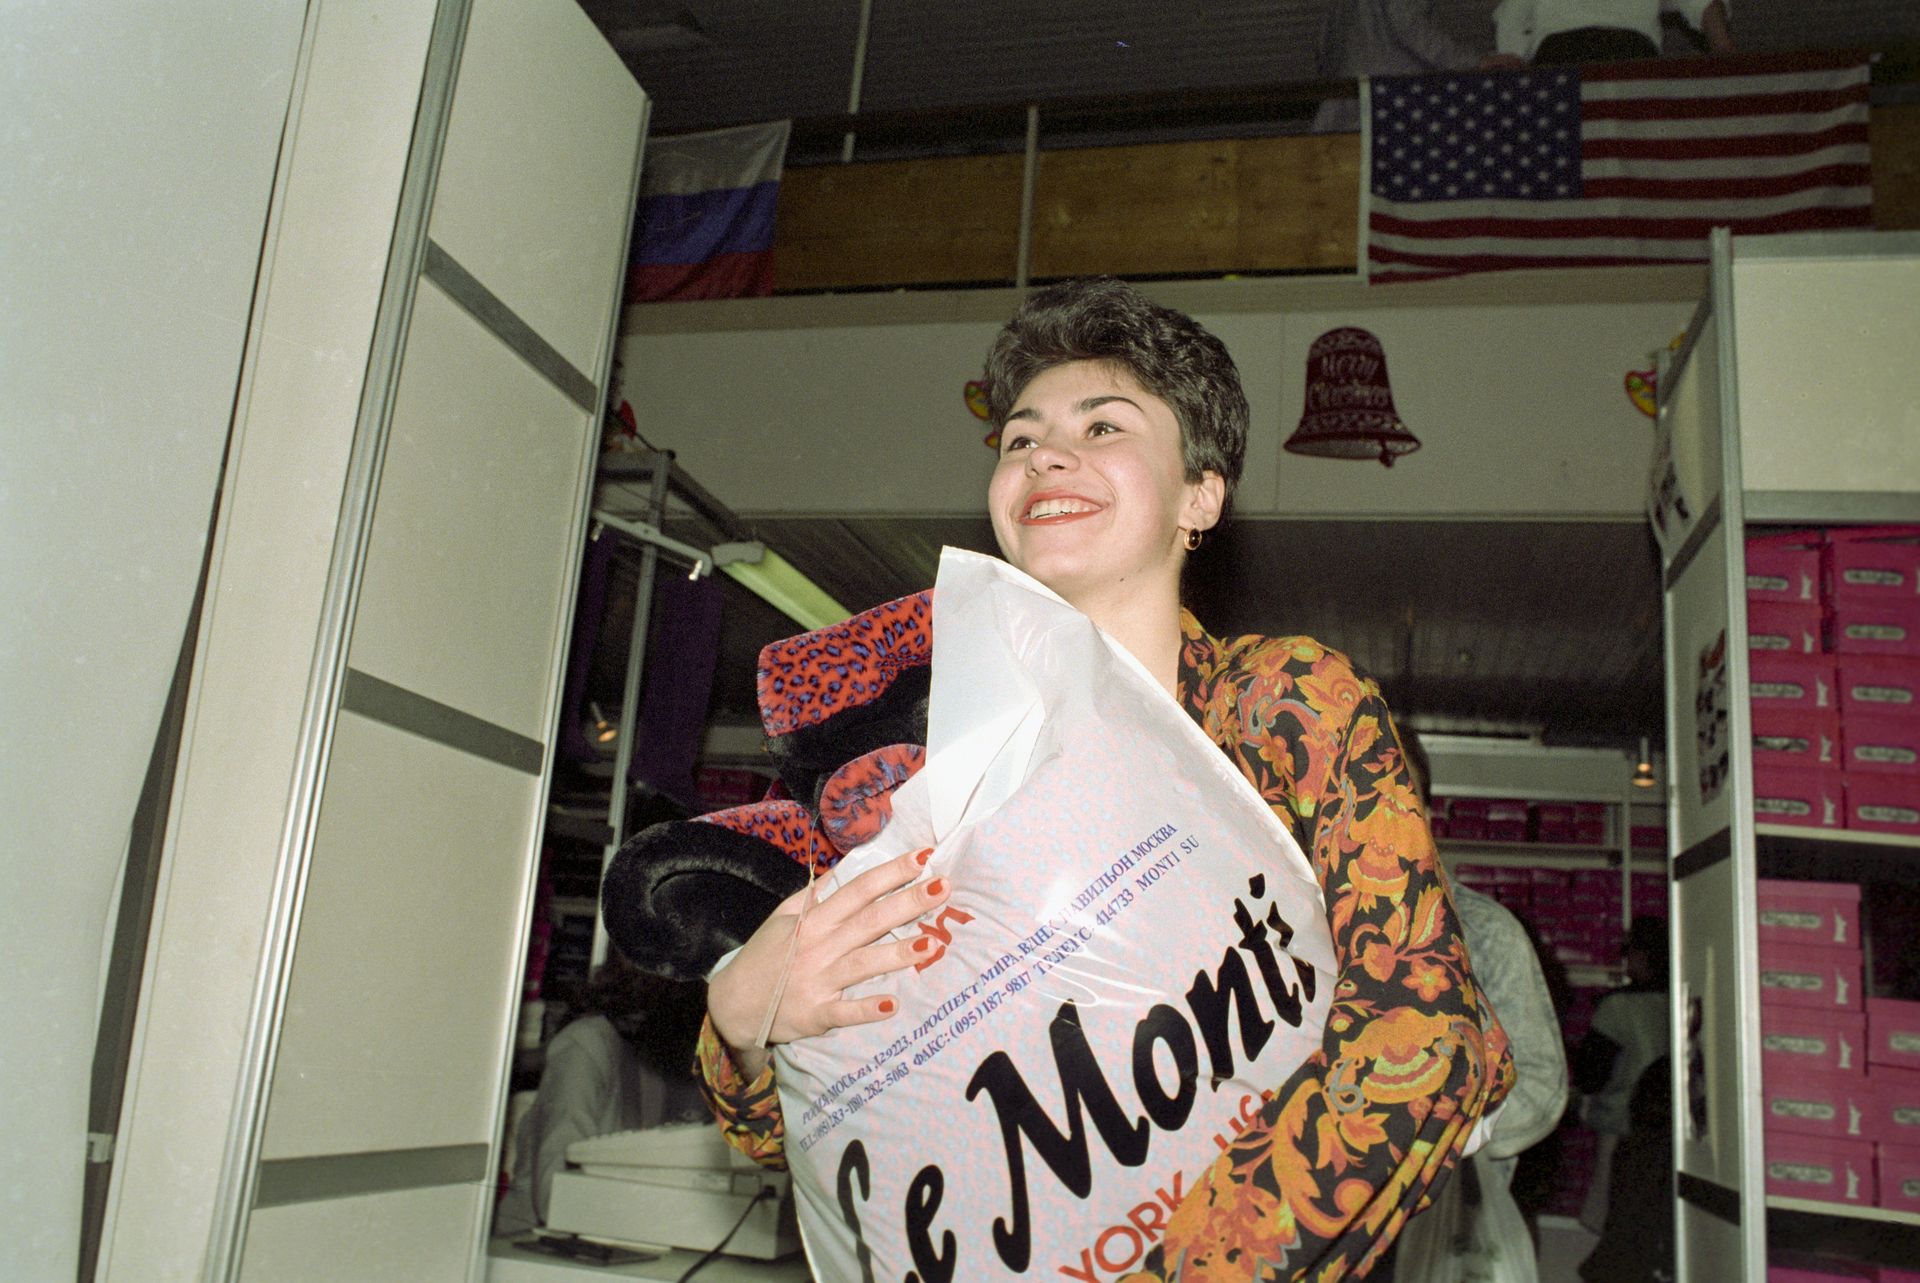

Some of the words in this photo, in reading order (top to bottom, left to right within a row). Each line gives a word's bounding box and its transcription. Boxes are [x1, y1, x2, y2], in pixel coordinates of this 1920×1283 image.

[913, 983, 980, 1041] ПРОСПЕКТ
[1130, 823, 1178, 862] МОСКВА
[1096, 888, 1135, 926] 414733
[1135, 850, 1181, 892] MONTI
[1180, 835, 1200, 854] SU
[965, 873, 1316, 1273] Monti
